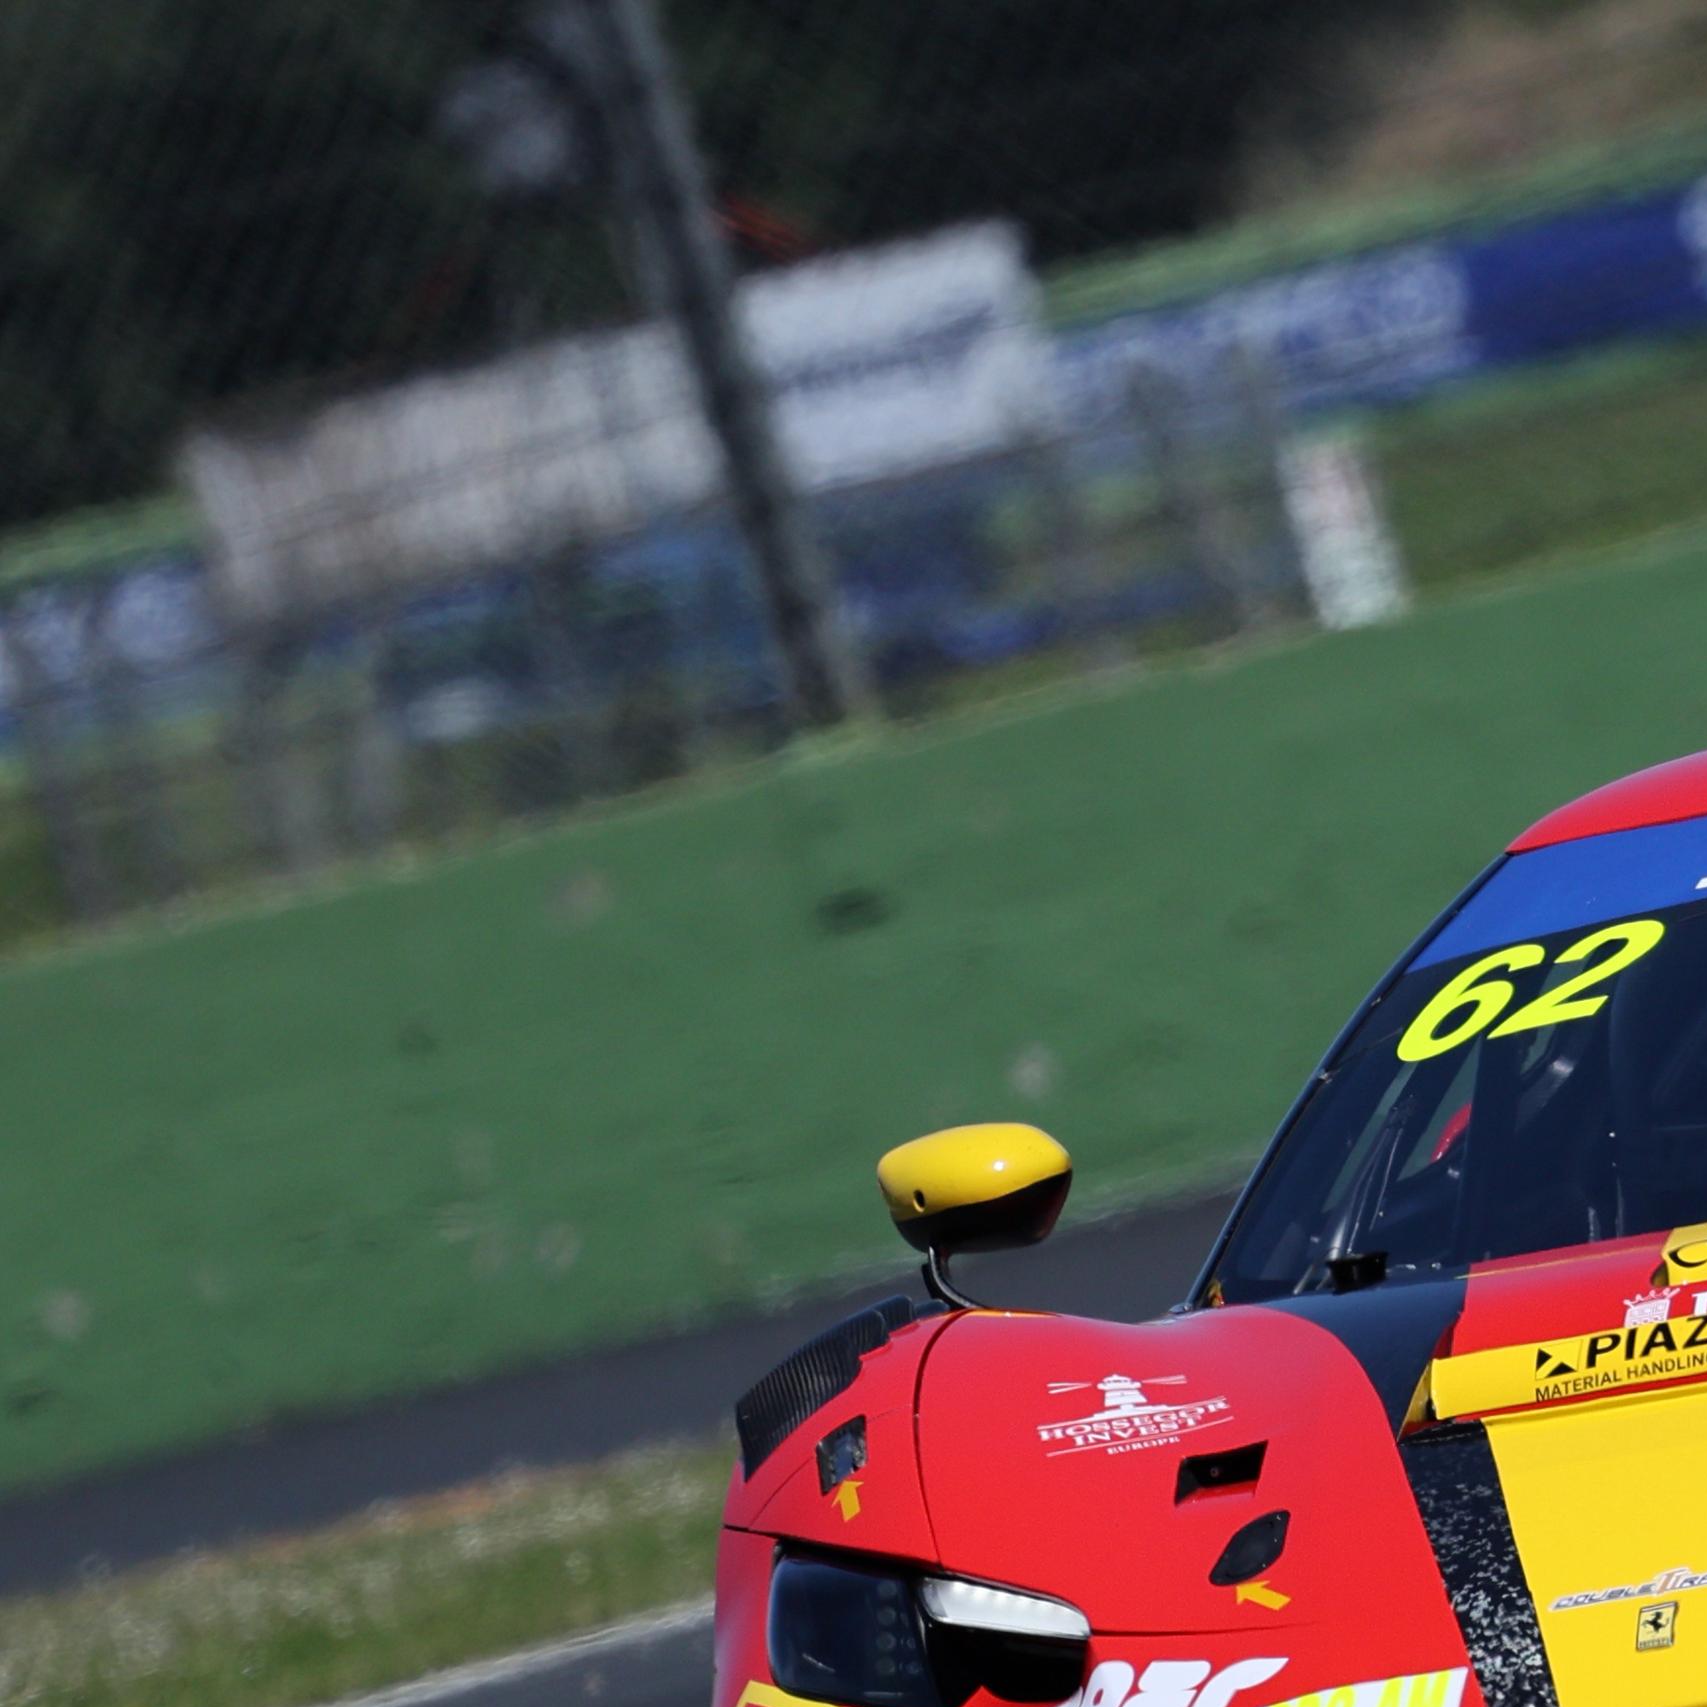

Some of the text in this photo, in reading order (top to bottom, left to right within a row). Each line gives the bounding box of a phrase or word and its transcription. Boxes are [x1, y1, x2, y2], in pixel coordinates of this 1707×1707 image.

[1397, 920, 1665, 1062] 62
[1534, 1368, 1623, 1403] MATERIAL
[1038, 1399, 1230, 1442] HOSSEGOR
[1074, 1413, 1203, 1446] INVEST
[1107, 1435, 1181, 1455] EUROPE
